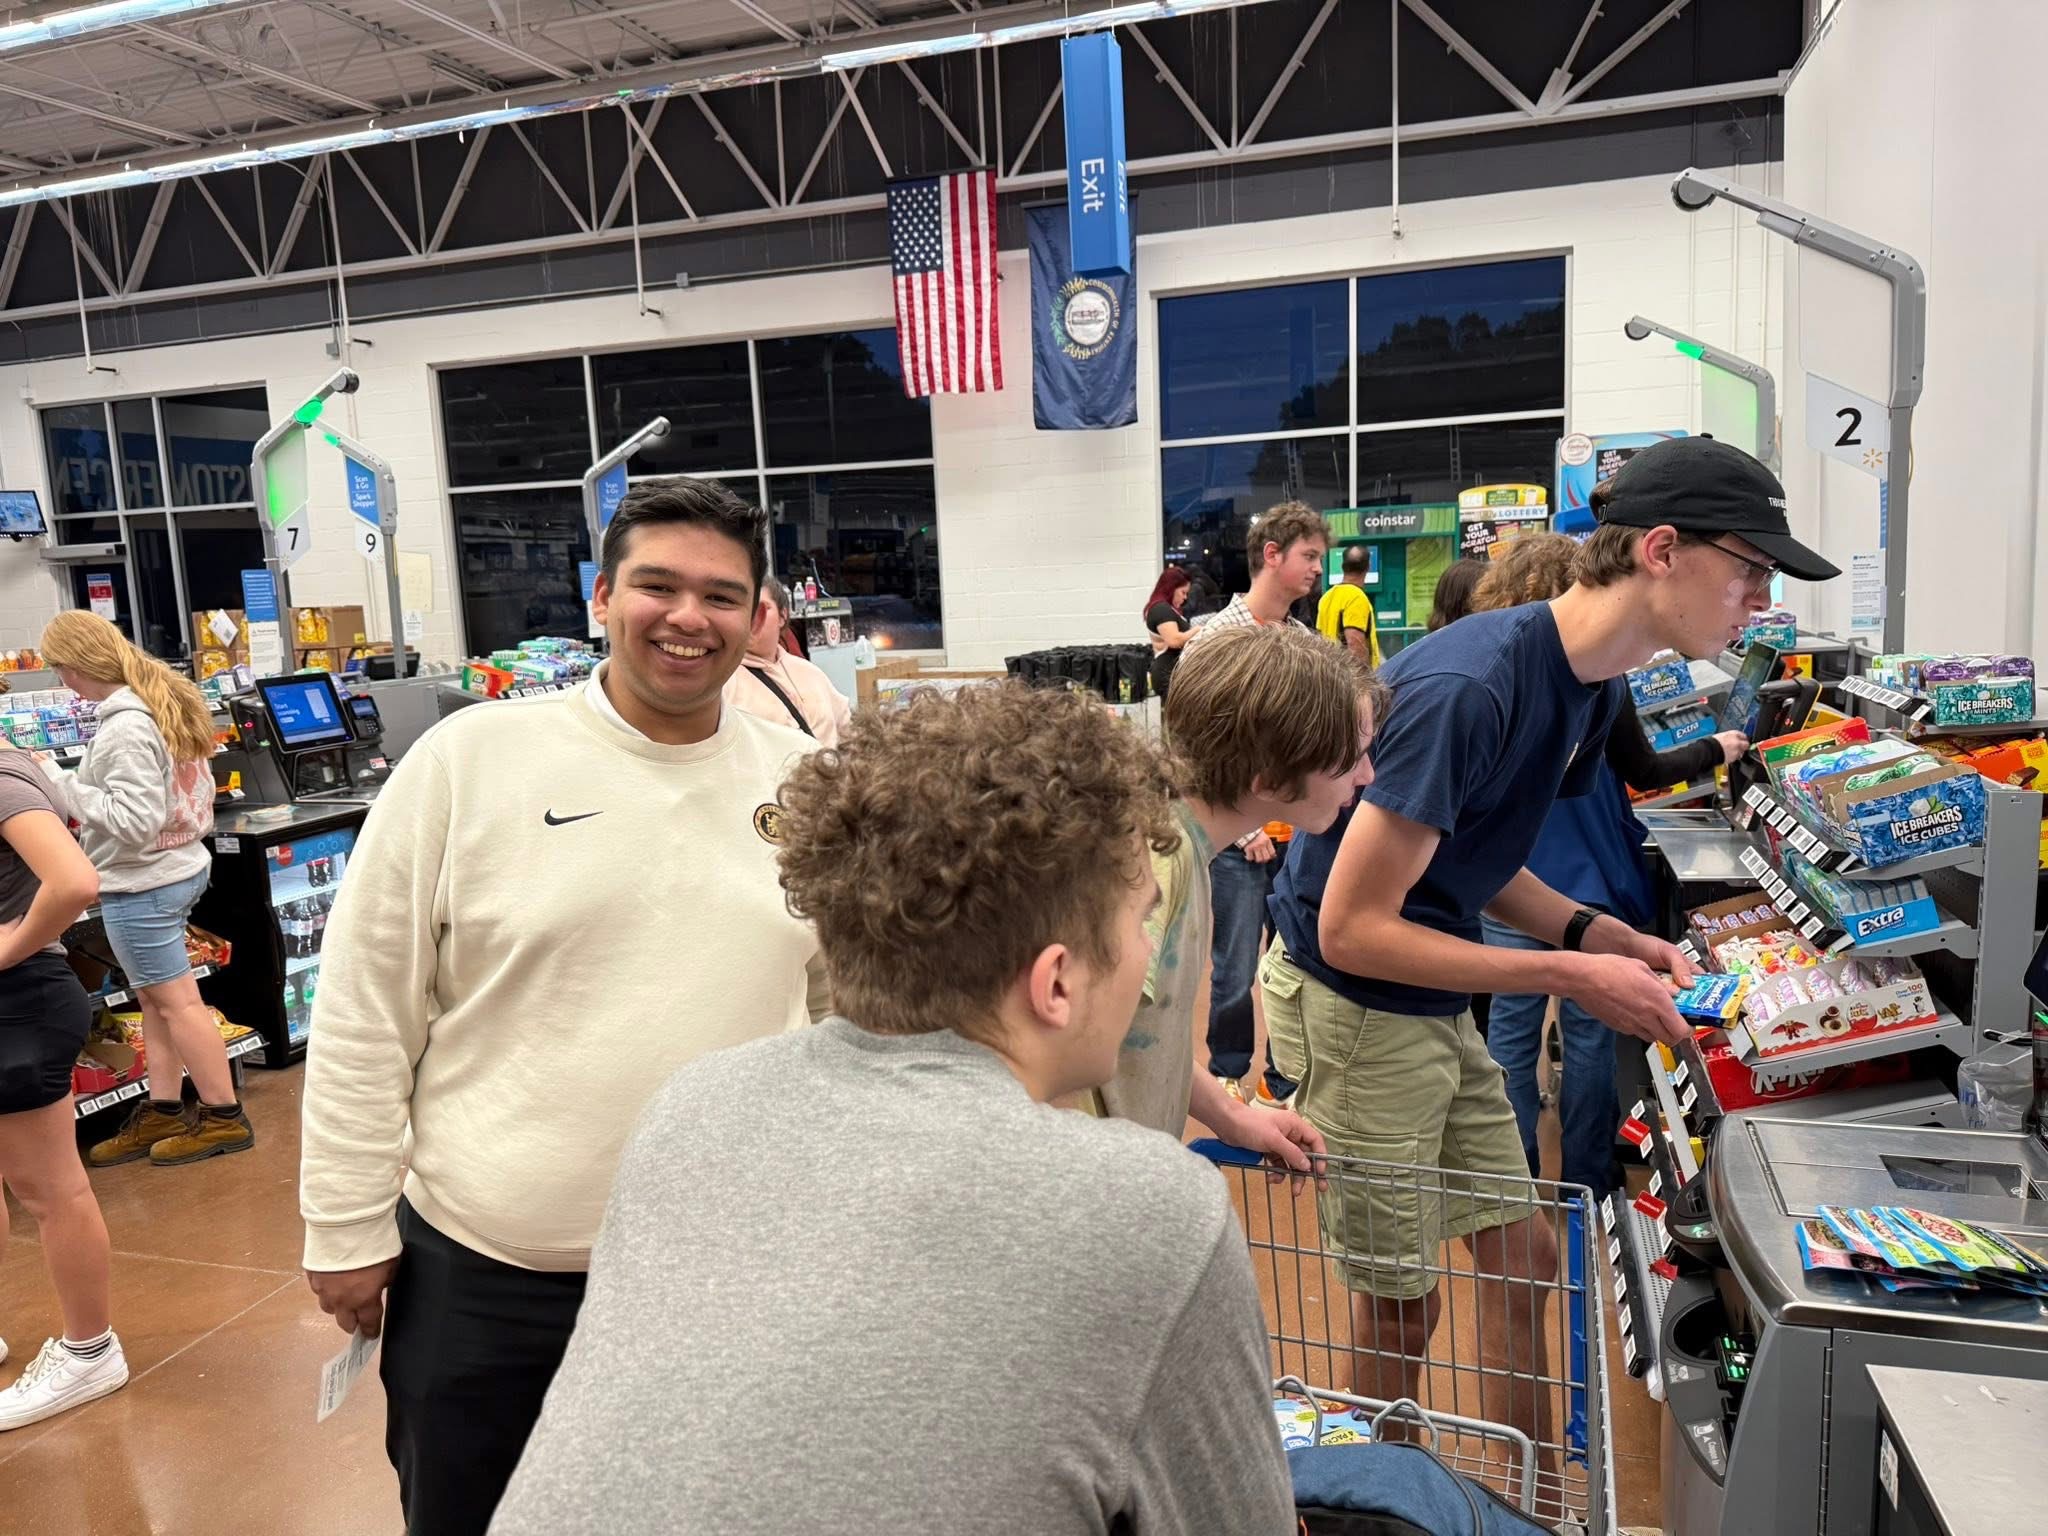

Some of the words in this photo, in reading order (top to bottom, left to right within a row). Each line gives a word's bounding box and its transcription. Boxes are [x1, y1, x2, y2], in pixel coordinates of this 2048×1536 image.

[1081, 158, 1105, 213] Exit
[1834, 407, 1862, 447] 2
[1364, 514, 1416, 527] coinstar
[1498, 508, 1545, 518] LOTTERY
[1465, 529, 1489, 540] YOUR
[1467, 522, 1484, 532] GET
[287, 527, 299, 551] 7
[365, 533, 377, 553] 9
[1460, 535, 1497, 549] SCRATCH
[1472, 545, 1486, 553] ON
[1958, 700, 1972, 713] ICE
[1972, 697, 2013, 710] BREAKERS
[1676, 721, 1699, 739] Extra
[1890, 822, 1910, 840] ICE
[1910, 805, 1963, 831] BREAKERS
[1901, 832, 1920, 846] ICE
[1920, 822, 1959, 841] CUBES
[1858, 906, 1905, 937] Extra
[1907, 983, 1924, 993] 100
